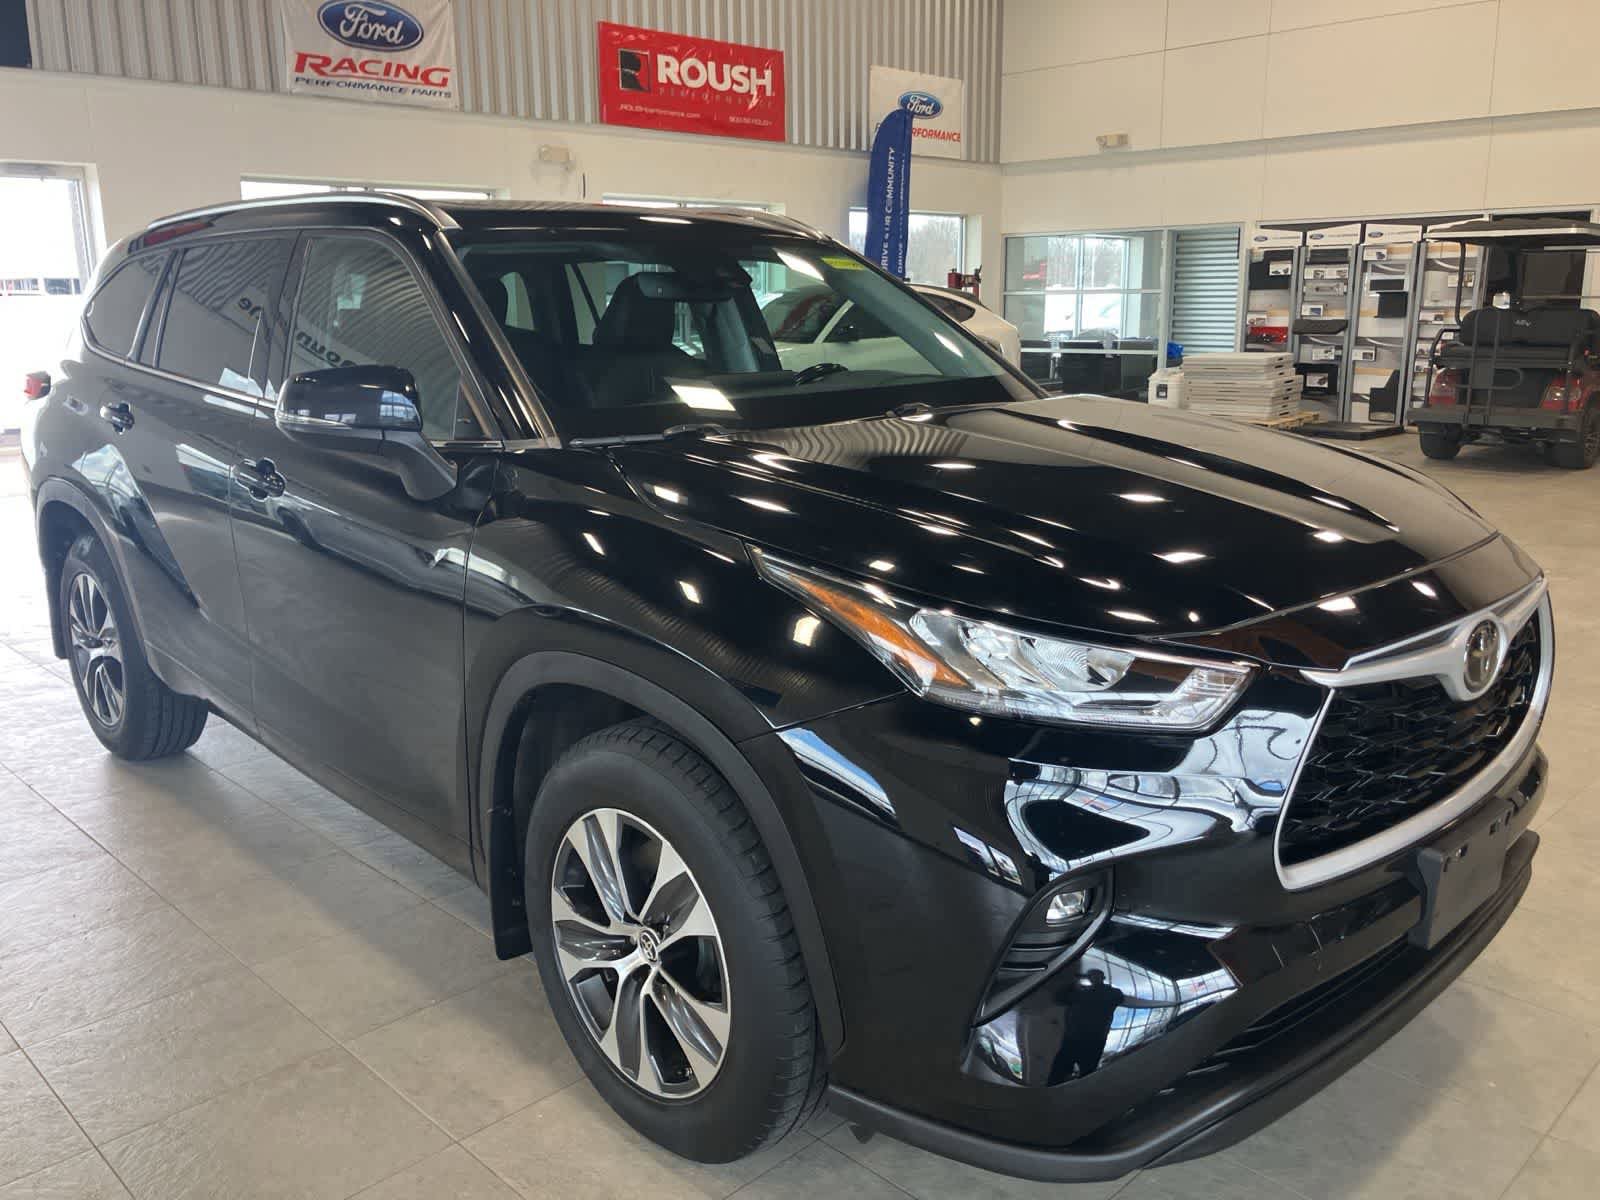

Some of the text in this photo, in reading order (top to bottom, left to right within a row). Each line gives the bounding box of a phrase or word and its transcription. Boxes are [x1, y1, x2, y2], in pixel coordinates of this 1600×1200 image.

[339, 3, 404, 45] Ford
[294, 51, 451, 88] RACING
[656, 54, 773, 98] ROUSH
[294, 76, 452, 99] PERFORMANCE PARTS
[906, 94, 936, 115] Ford
[911, 127, 961, 143] RFORMANCE
